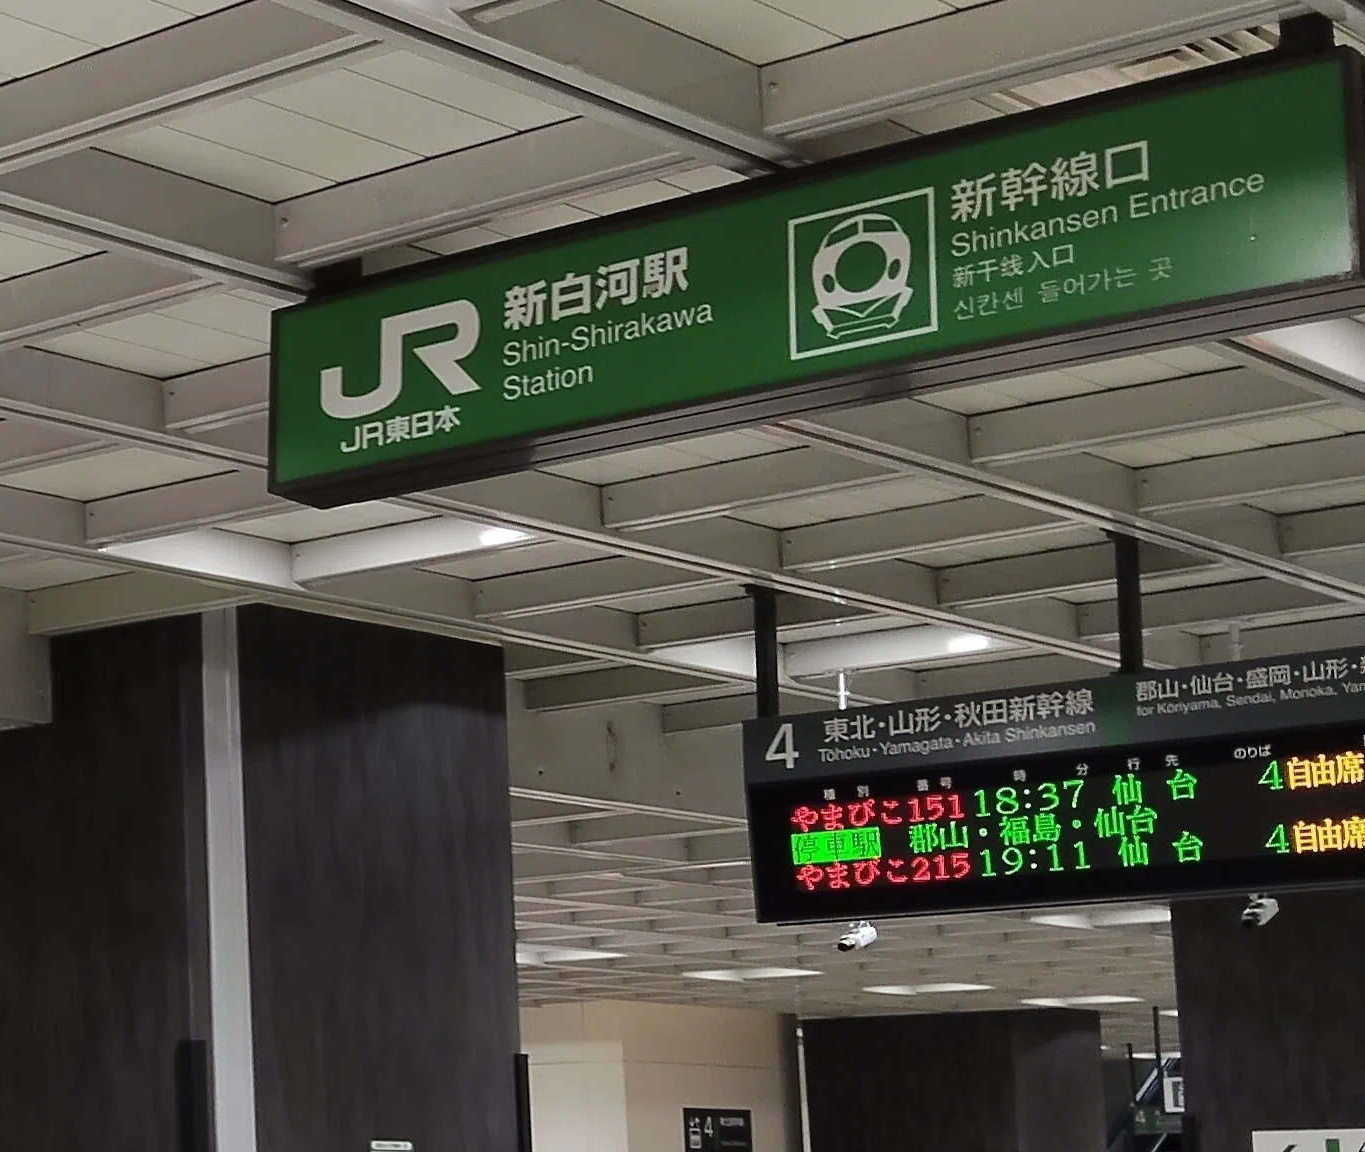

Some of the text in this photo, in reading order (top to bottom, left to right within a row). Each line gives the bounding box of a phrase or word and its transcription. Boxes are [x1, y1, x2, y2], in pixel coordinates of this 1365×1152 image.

[950, 140, 1152, 223] 新幹線口
[950, 172, 1265, 257] Shinkansen Entrance
[503, 247, 689, 332] 新白河駅
[952, 243, 1075, 288] 新干线入口
[953, 256, 1173, 321] 신칸센 들어가는 곳
[320, 299, 482, 419] JR
[502, 302, 714, 367] Shin-Shirakawa
[502, 363, 594, 400] Station
[340, 405, 461, 453] JR東日本
[823, 688, 1095, 744] 東北・山形・秋田新幹線
[1005, 720, 1097, 744] Shinkansen
[765, 723, 800, 770] 4
[1234, 745, 1271, 759] のりば
[973, 778, 1084, 818] 18:37
[1257, 760, 1284, 790] 4
[1286, 751, 1365, 791] 自由席
[979, 840, 1091, 877] 19:11
[1265, 823, 1290, 854] 4
